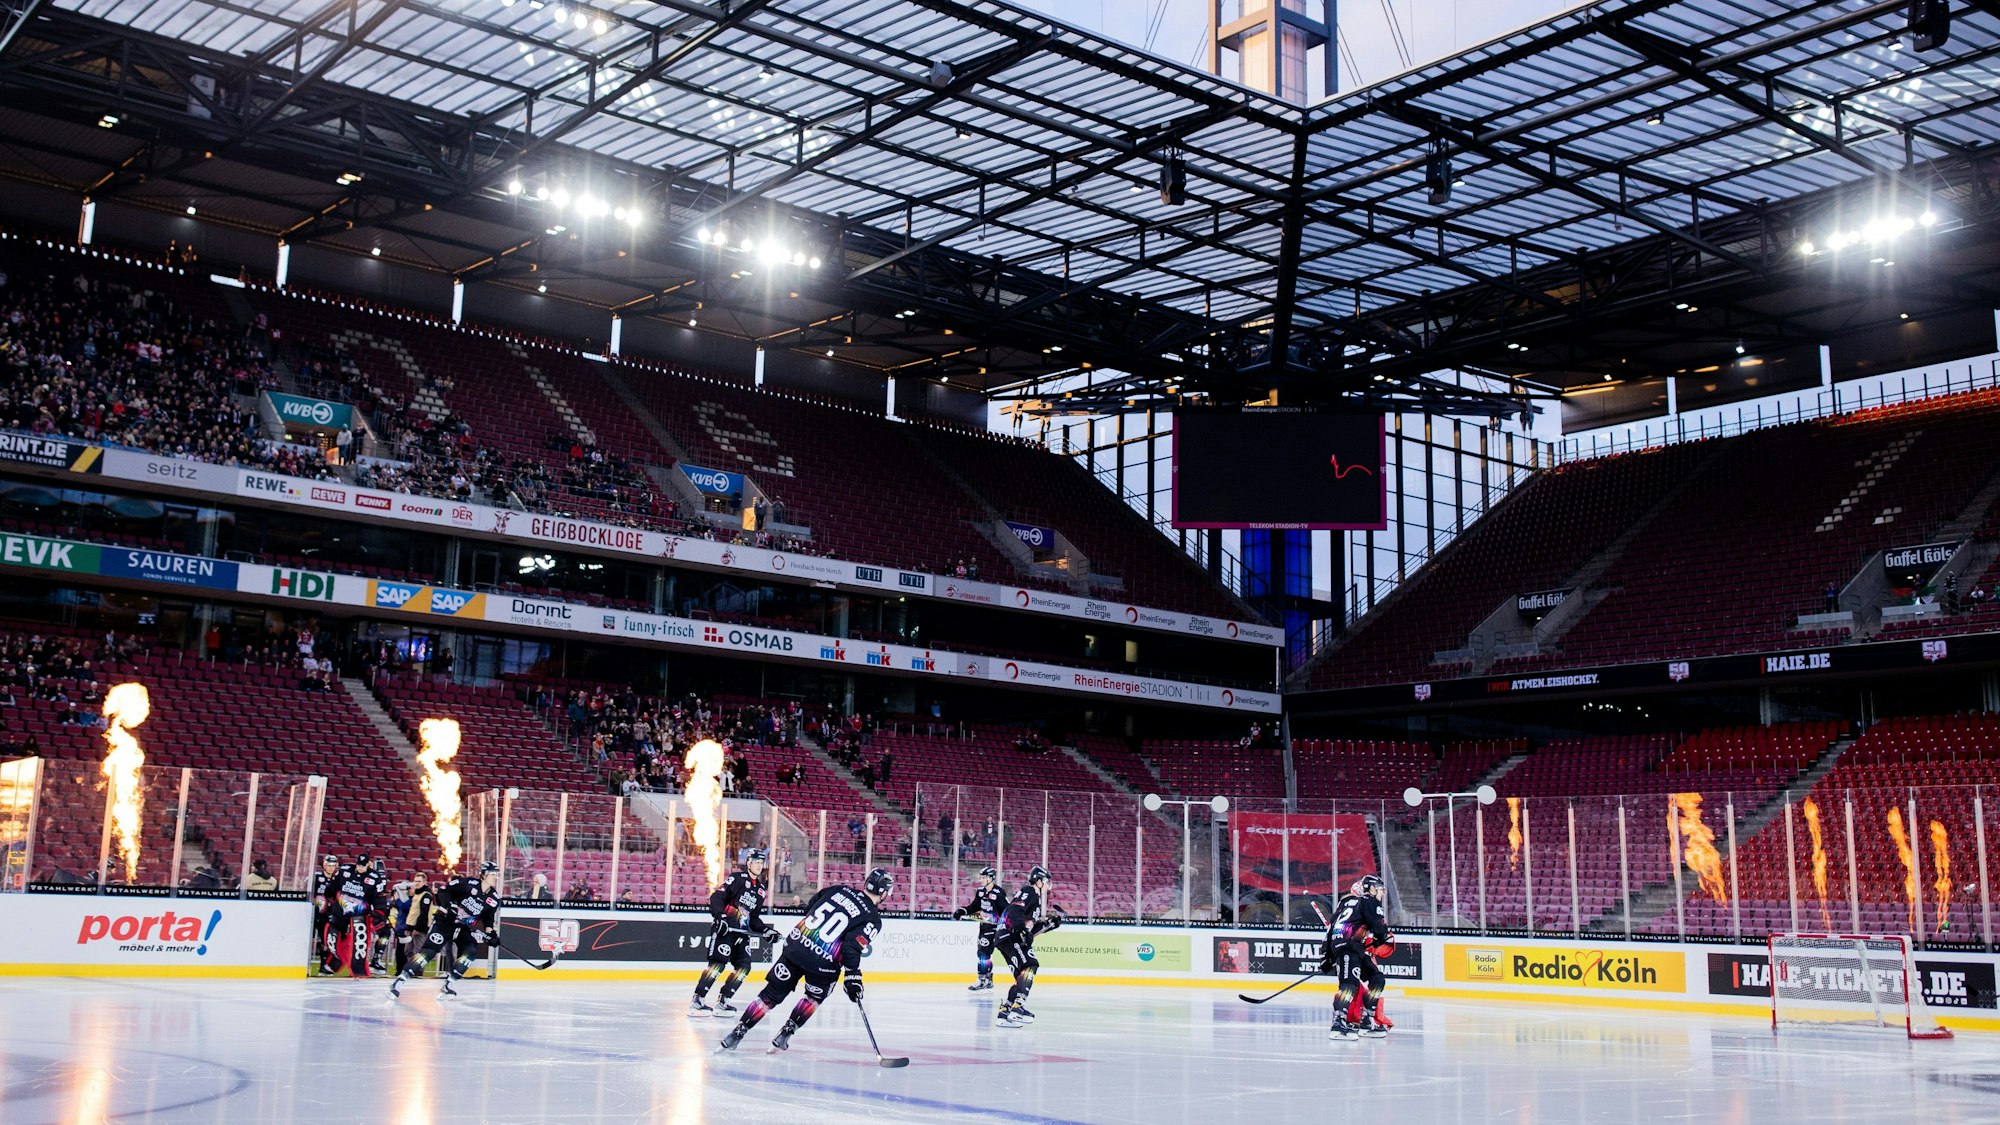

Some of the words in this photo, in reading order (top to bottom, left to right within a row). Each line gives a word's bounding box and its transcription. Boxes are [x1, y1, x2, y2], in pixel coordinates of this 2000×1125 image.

[283, 401, 312, 417] KVB
[147, 462, 197, 480] seitz
[245, 475, 287, 493] REWE
[691, 472, 712, 486] KVB
[312, 488, 344, 503] REWE
[401, 503, 433, 515] toom
[453, 508, 472, 521] DER
[0, 536, 73, 569] EVK
[1885, 550, 1922, 568] Gaffel
[128, 551, 214, 577] SAUREN
[857, 567, 881, 581] UTH
[900, 574, 924, 588] UTH
[271, 568, 335, 601] HDI
[377, 586, 411, 605] SAP
[432, 592, 464, 612] SAP
[1518, 595, 1546, 610] Gaffel
[512, 599, 572, 619] Dorint
[1031, 597, 1071, 610] RheinEnergie
[1087, 601, 1107, 611] Rhein
[1084, 607, 1111, 619] Energie
[1139, 613, 1176, 625] RheinEnergie
[511, 615, 534, 625] Hotels
[543, 618, 572, 629] Resorts
[624, 616, 695, 638] funny-frisch
[1191, 616, 1209, 626] Rhein
[1188, 622, 1213, 635] Energie
[1239, 628, 1273, 640] RheinEnergie
[729, 630, 793, 651] OSMAB
[1766, 652, 1831, 673] HAIE.DE
[1020, 668, 1061, 682] RheinEnergie
[1235, 694, 1270, 708] RheinEnergie
[345, 881, 363, 892] Rhein
[804, 901, 849, 944] 50
[539, 918, 580, 951] 50
[863, 922, 878, 940] 50
[883, 933, 940, 944] MEDIAPARK
[942, 934, 973, 946] KLINIK
[119, 943, 155, 952] möbel
[156, 944, 163, 952] &
[166, 943, 195, 953] mehr
[800, 934, 833, 962] TOYOTA
[882, 946, 909, 959] KÖLN
[1060, 946, 1083, 954] BANDE
[1102, 947, 1122, 955] SPIEL.
[1136, 946, 1151, 954] VRS
[1254, 942, 1284, 958] DIE
[1474, 954, 1497, 963] Radio
[1477, 963, 1495, 972] Köln
[1513, 954, 1582, 981] Radio
[1598, 957, 1657, 983] Köln
